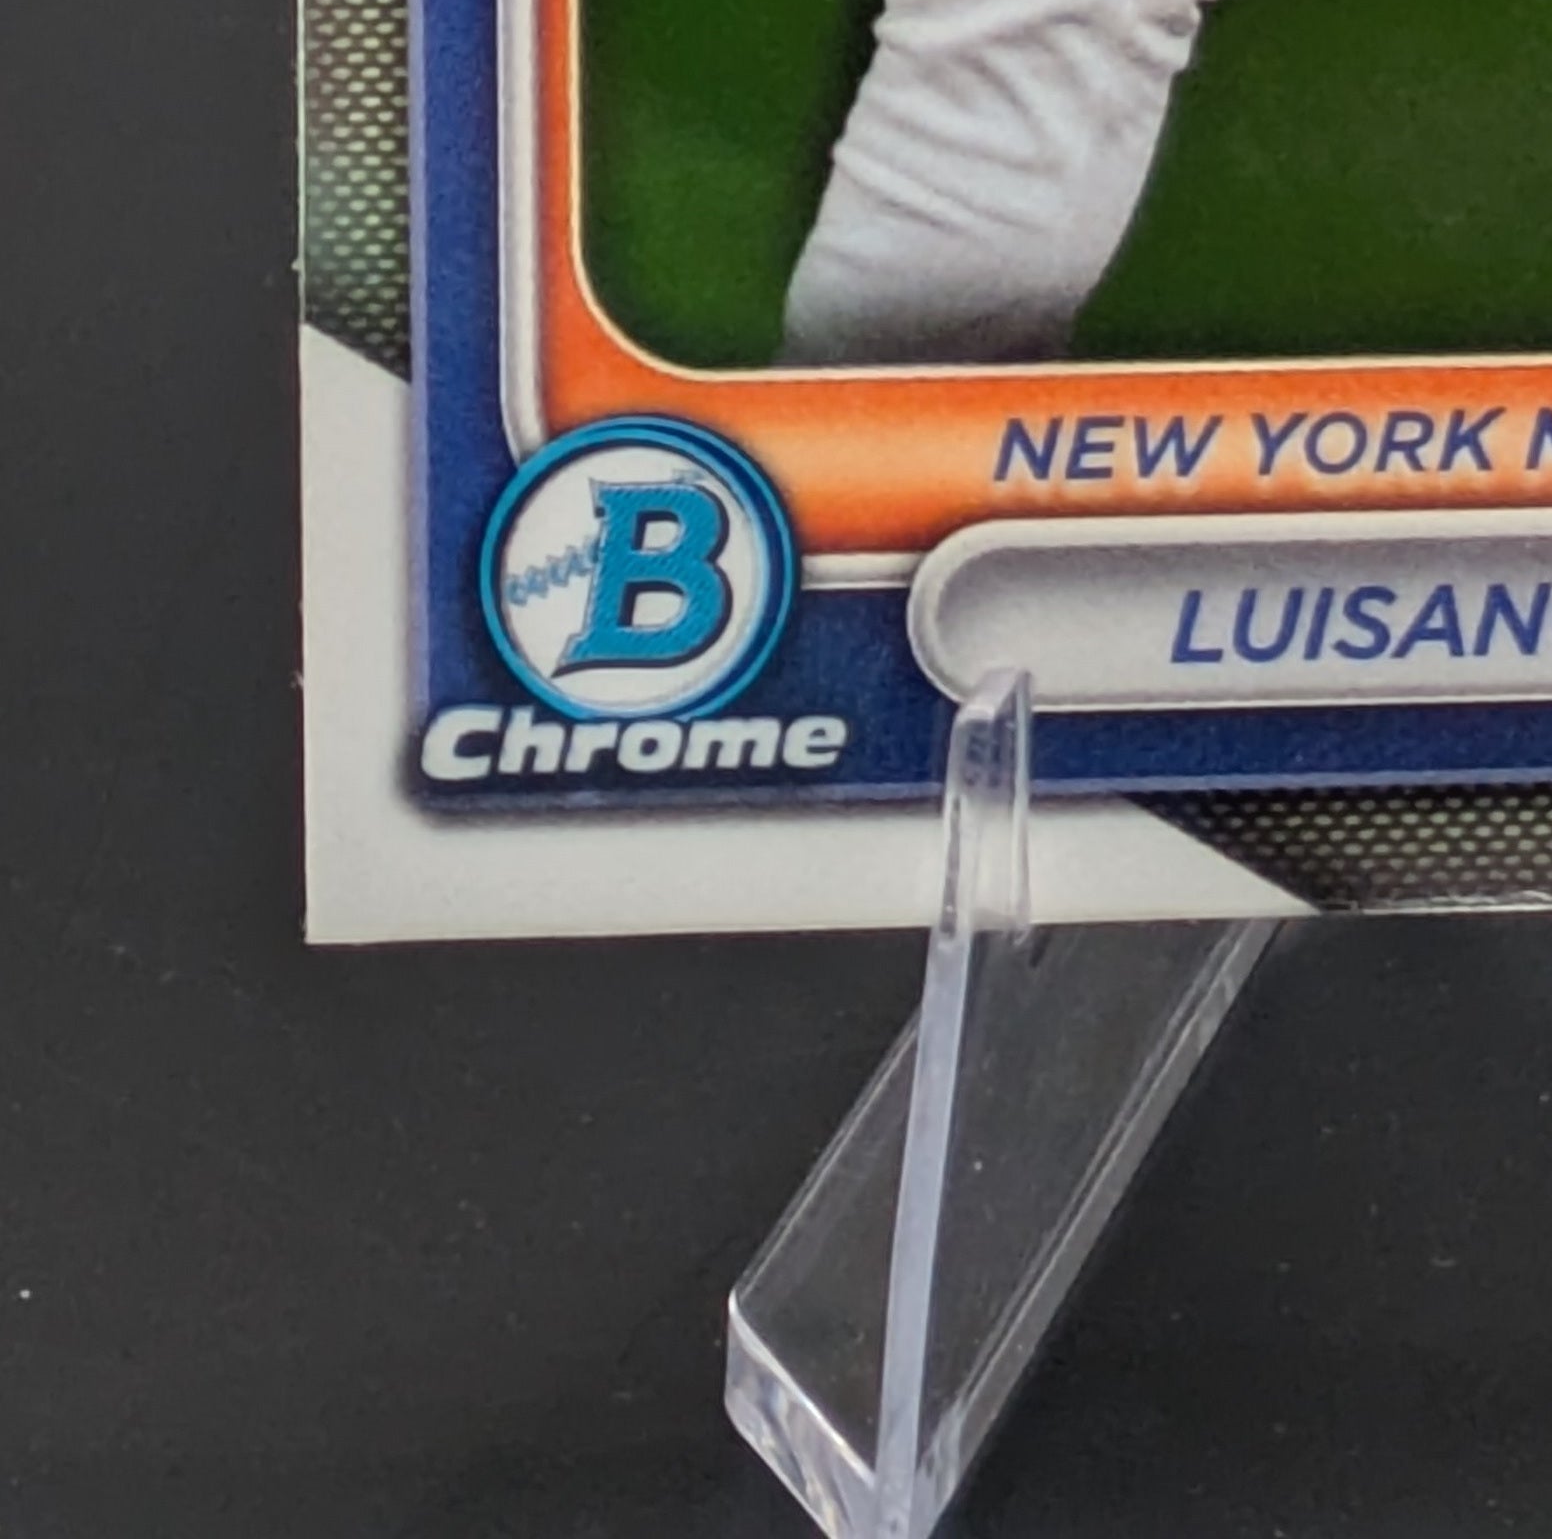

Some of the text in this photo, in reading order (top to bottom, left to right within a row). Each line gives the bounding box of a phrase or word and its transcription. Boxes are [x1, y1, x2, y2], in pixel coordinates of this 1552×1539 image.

[993, 415, 1223, 482] NEW
[1251, 406, 1507, 476] YORK
[551, 477, 734, 680] B
[420, 704, 848, 781] Chrome
